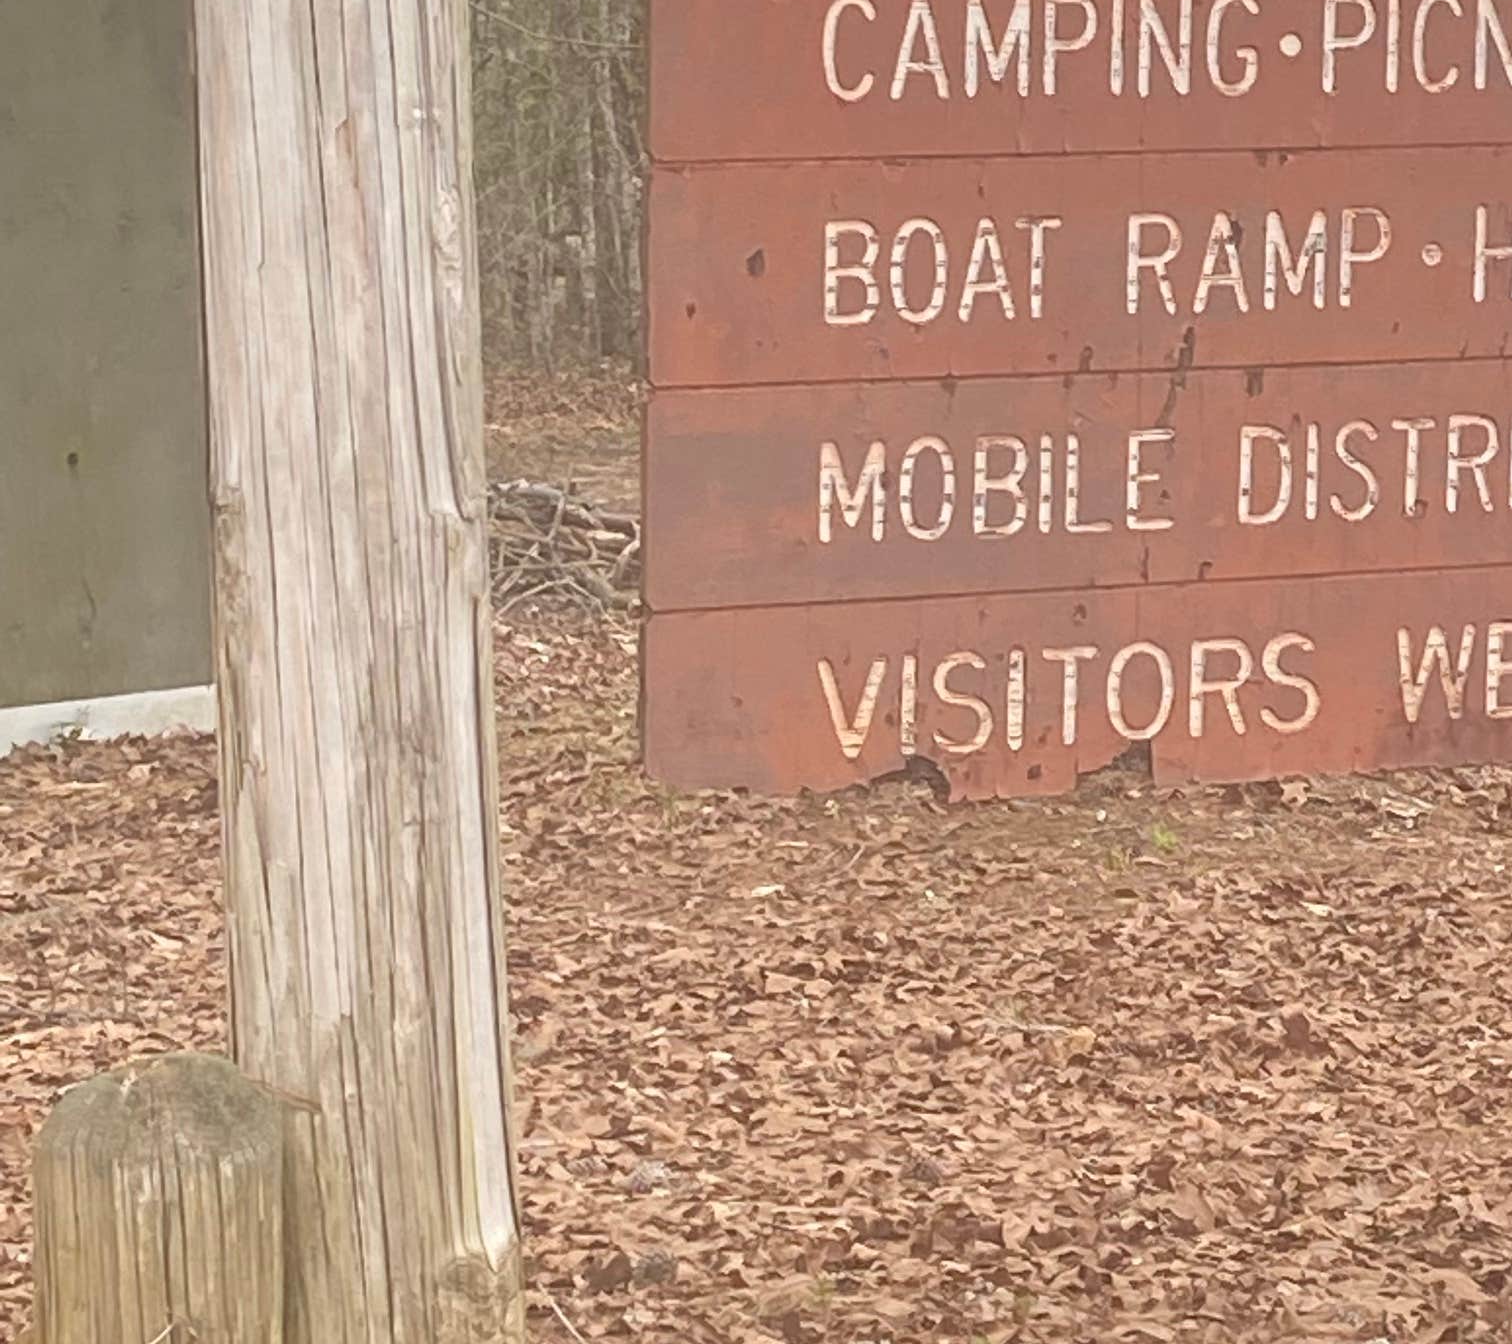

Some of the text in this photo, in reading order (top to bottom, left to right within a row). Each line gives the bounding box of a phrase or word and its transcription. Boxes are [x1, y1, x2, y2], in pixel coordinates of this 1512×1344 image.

[823, 216, 1063, 326] BOAT
[1126, 206, 1392, 316] RAMP
[818, 428, 1176, 543] MOBILE
[816, 632, 1321, 759] VISITORS
